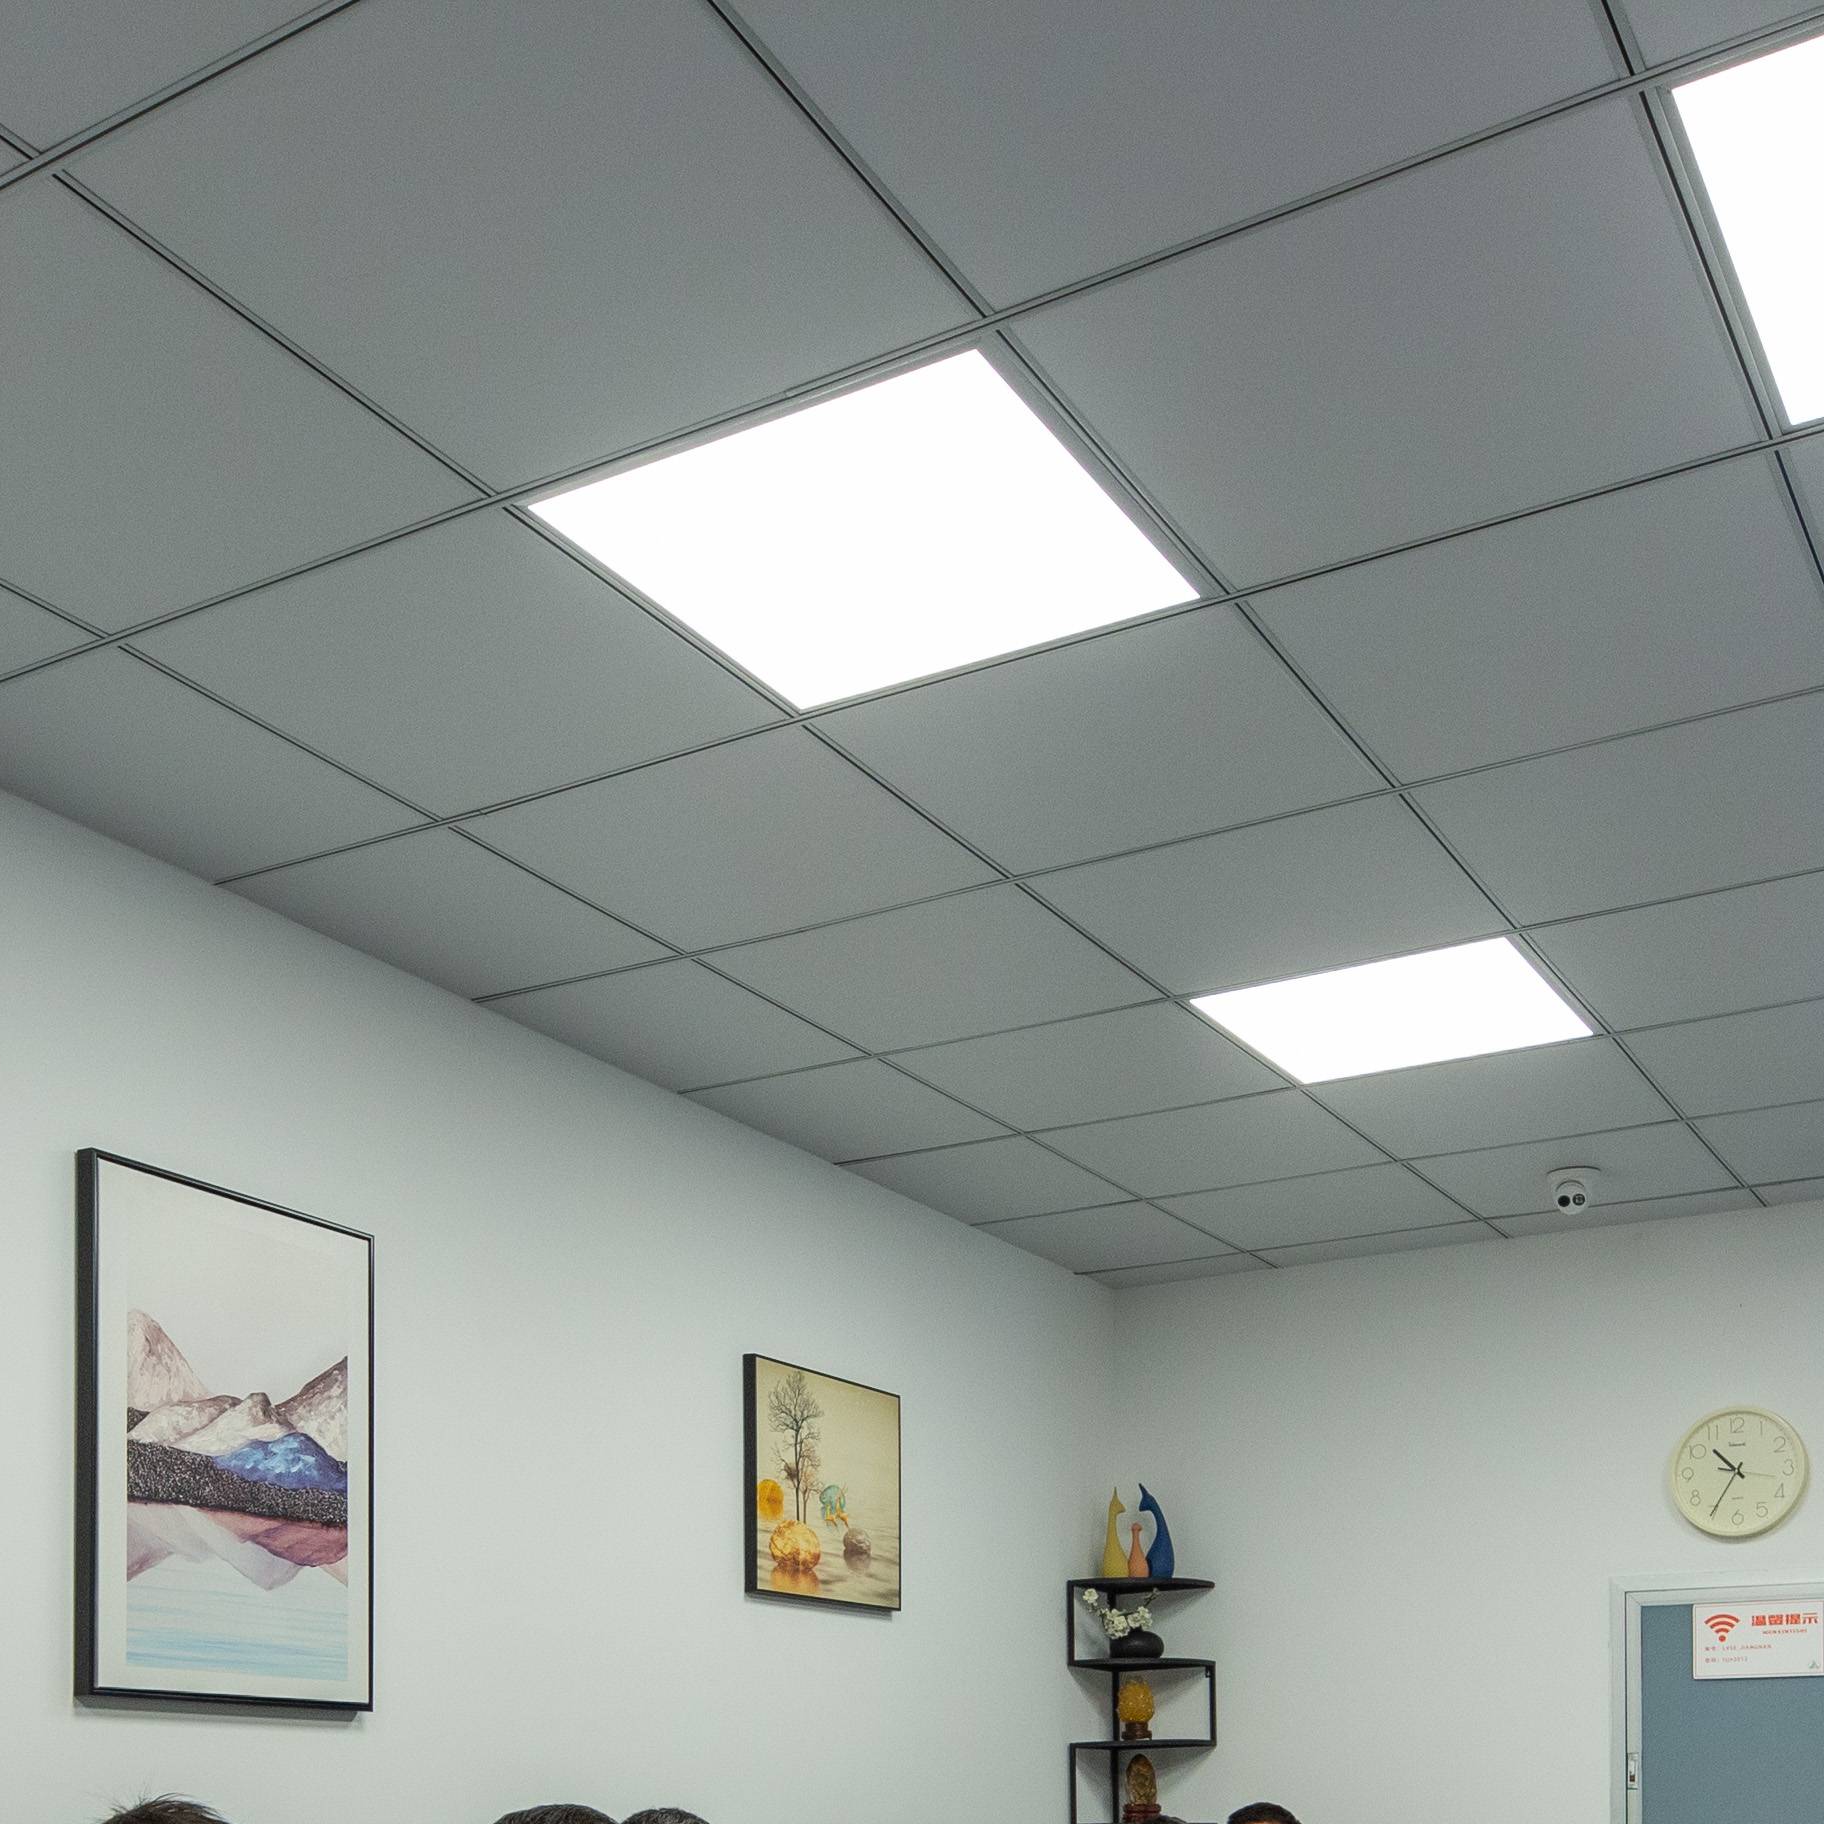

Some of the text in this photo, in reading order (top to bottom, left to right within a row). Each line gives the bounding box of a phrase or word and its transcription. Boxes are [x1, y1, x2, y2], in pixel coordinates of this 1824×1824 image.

[1707, 1424, 1719, 1441] 11
[1730, 1417, 1744, 1433] 12
[1689, 1443, 1707, 1460] 10
[1773, 1436, 1786, 1453] 2
[1681, 1467, 1695, 1483] 9
[1783, 1459, 1794, 1476] 3
[1690, 1489, 1701, 1506] 8
[1774, 1483, 1785, 1498] 4
[1731, 1509, 1744, 1525] 6
[1756, 1502, 1769, 1518] 5
